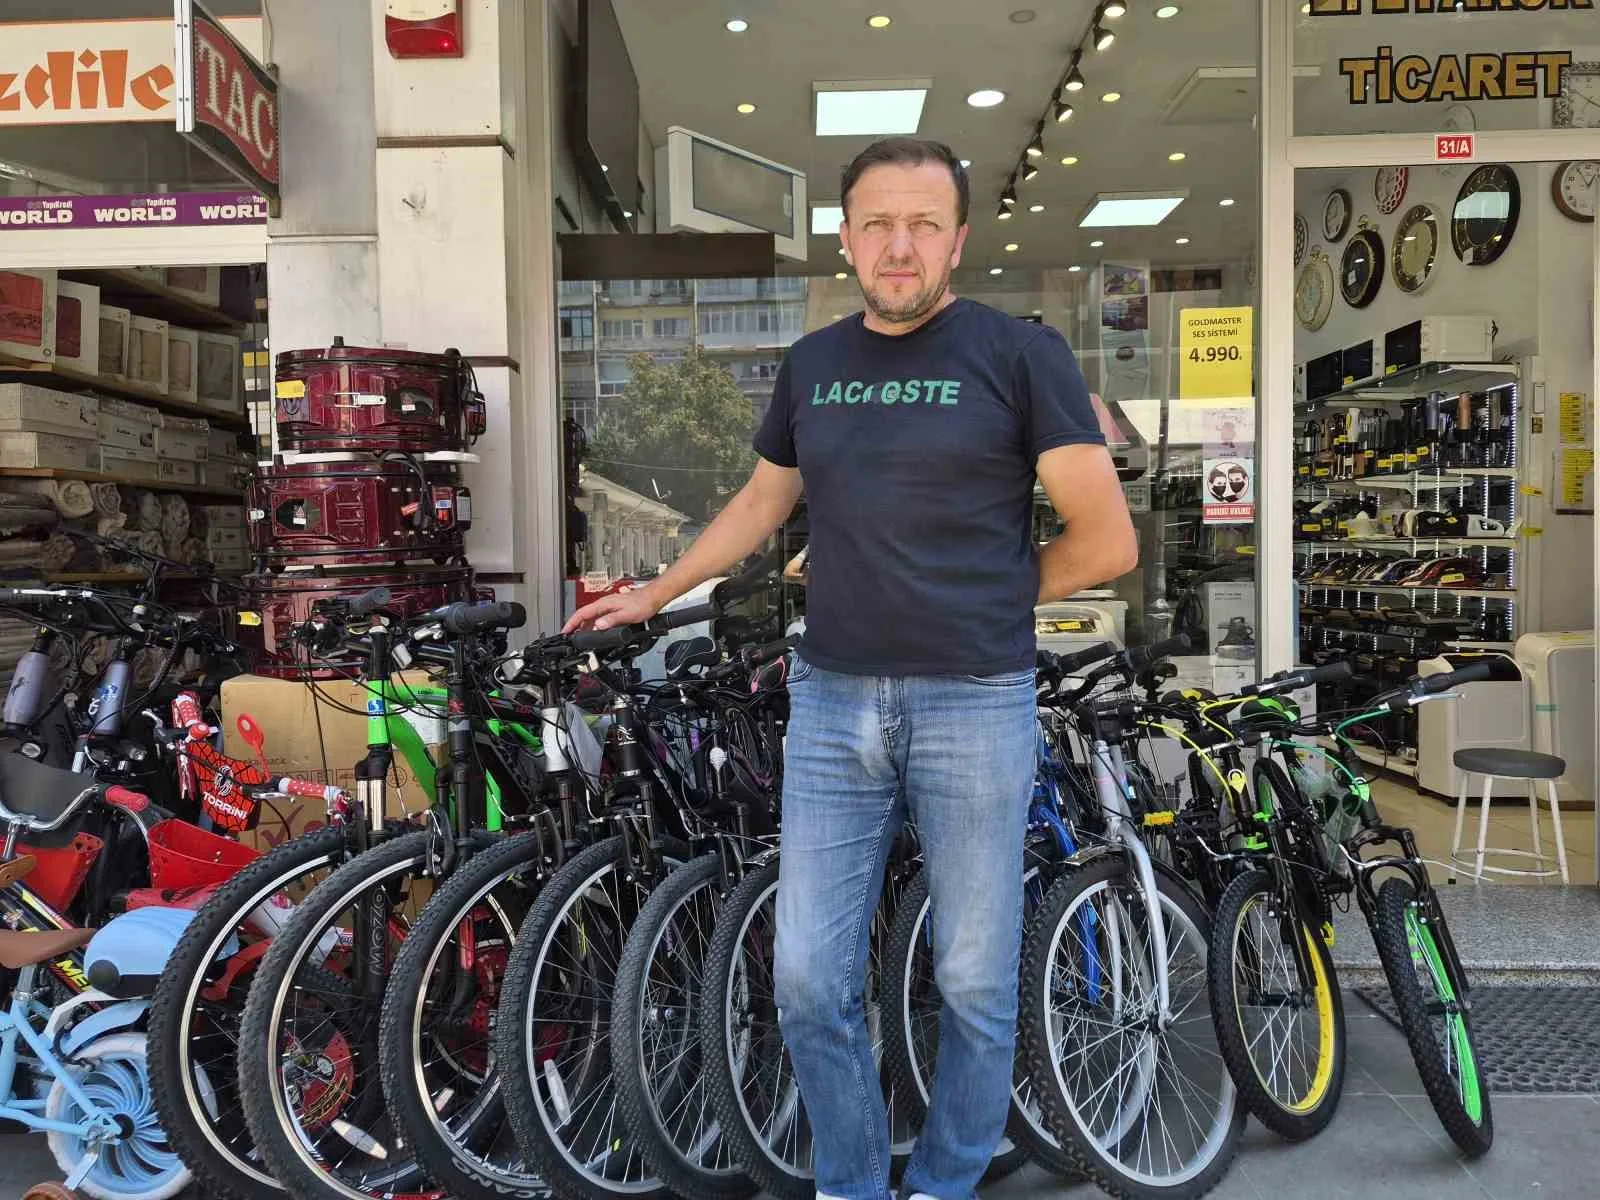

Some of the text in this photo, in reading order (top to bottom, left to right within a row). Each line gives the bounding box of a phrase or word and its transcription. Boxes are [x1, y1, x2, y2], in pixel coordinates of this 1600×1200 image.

[1339, 46, 1573, 104] TİCARET
[201, 42, 276, 169] TAÇ
[1440, 139, 1470, 154] 31/A
[93, 206, 177, 222] WORLD
[1188, 316, 1242, 327] GOLDMASTER
[1192, 329, 1206, 338] SES
